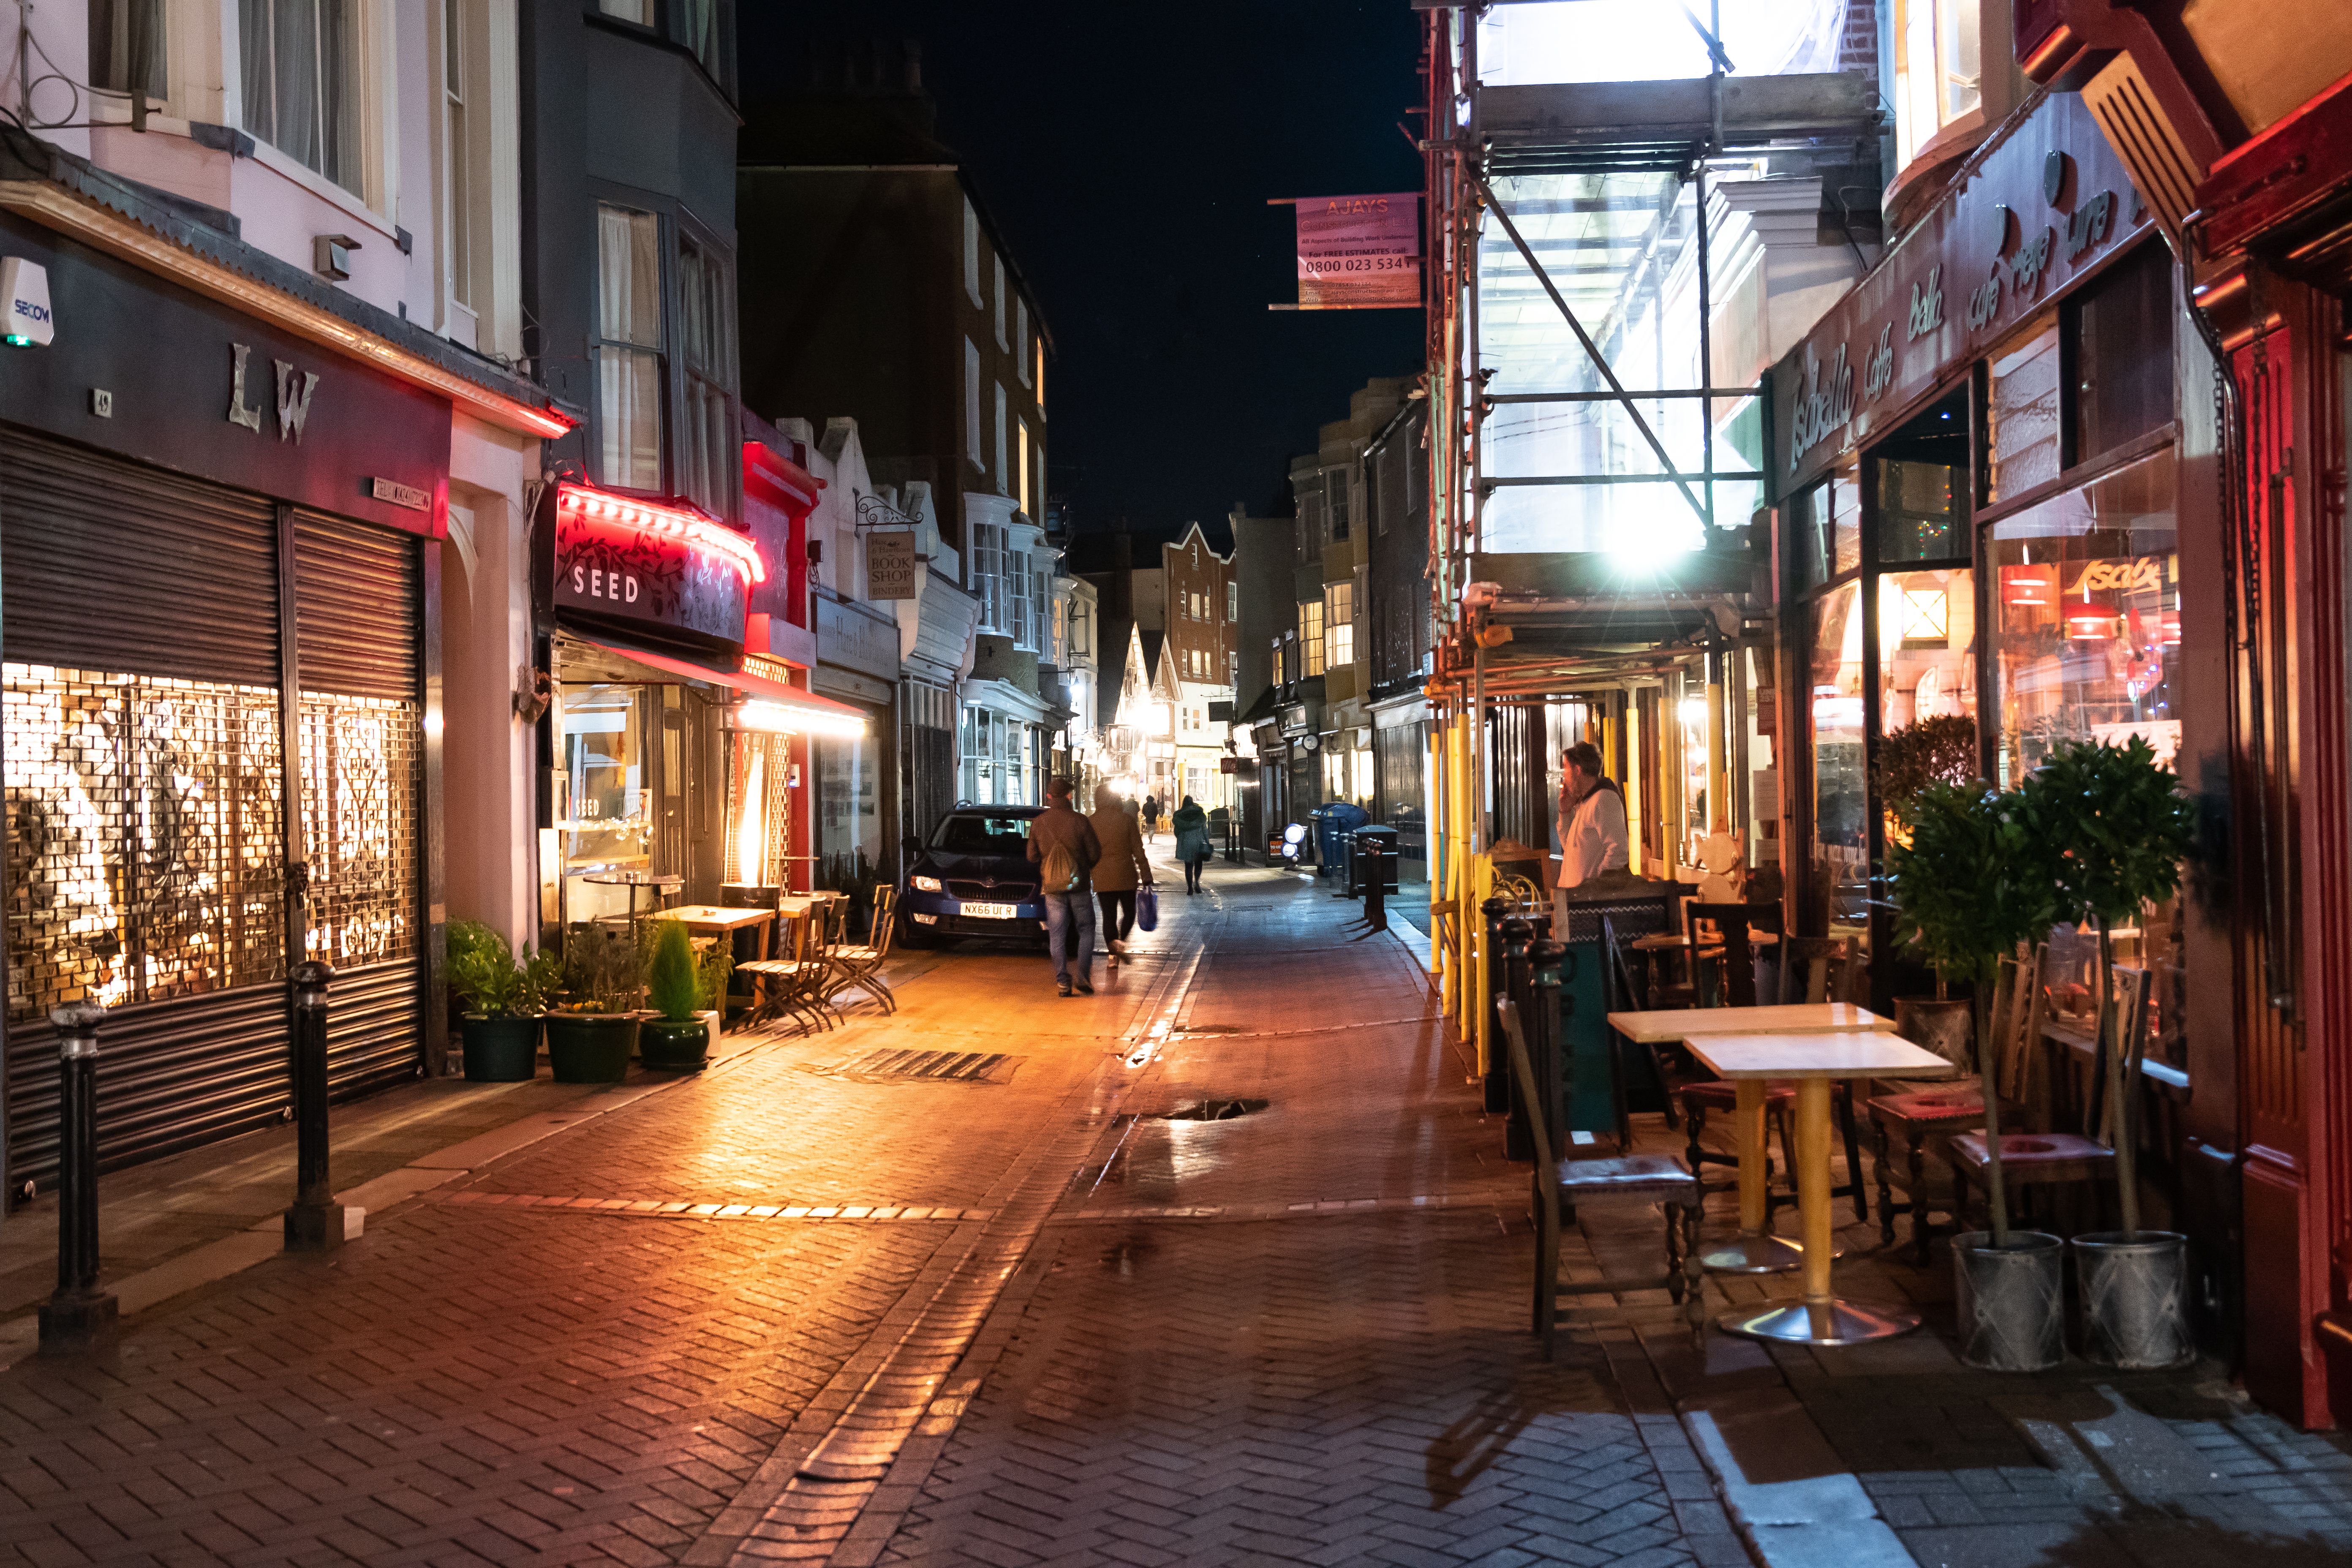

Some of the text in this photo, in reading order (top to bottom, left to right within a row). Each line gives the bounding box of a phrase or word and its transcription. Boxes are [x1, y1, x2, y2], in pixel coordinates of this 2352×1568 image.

[1326, 199, 1389, 215] AJAYS
[1345, 248, 1390, 256] ESTIMATES
[1306, 260, 1341, 273] 0800
[1345, 259, 1372, 271] 023
[15, 299, 49, 324] SECOM
[1790, 341, 1858, 476] Isabella
[1907, 263, 1944, 342] Bella
[98, 394, 109, 412] 49
[872, 557, 911, 569] BOOK
[574, 565, 638, 603] SEED
[871, 570, 912, 583] SHOP
[872, 586, 911, 595] BINDERY
[575, 798, 599, 817] SEED
[965, 904, 990, 915] NX66
